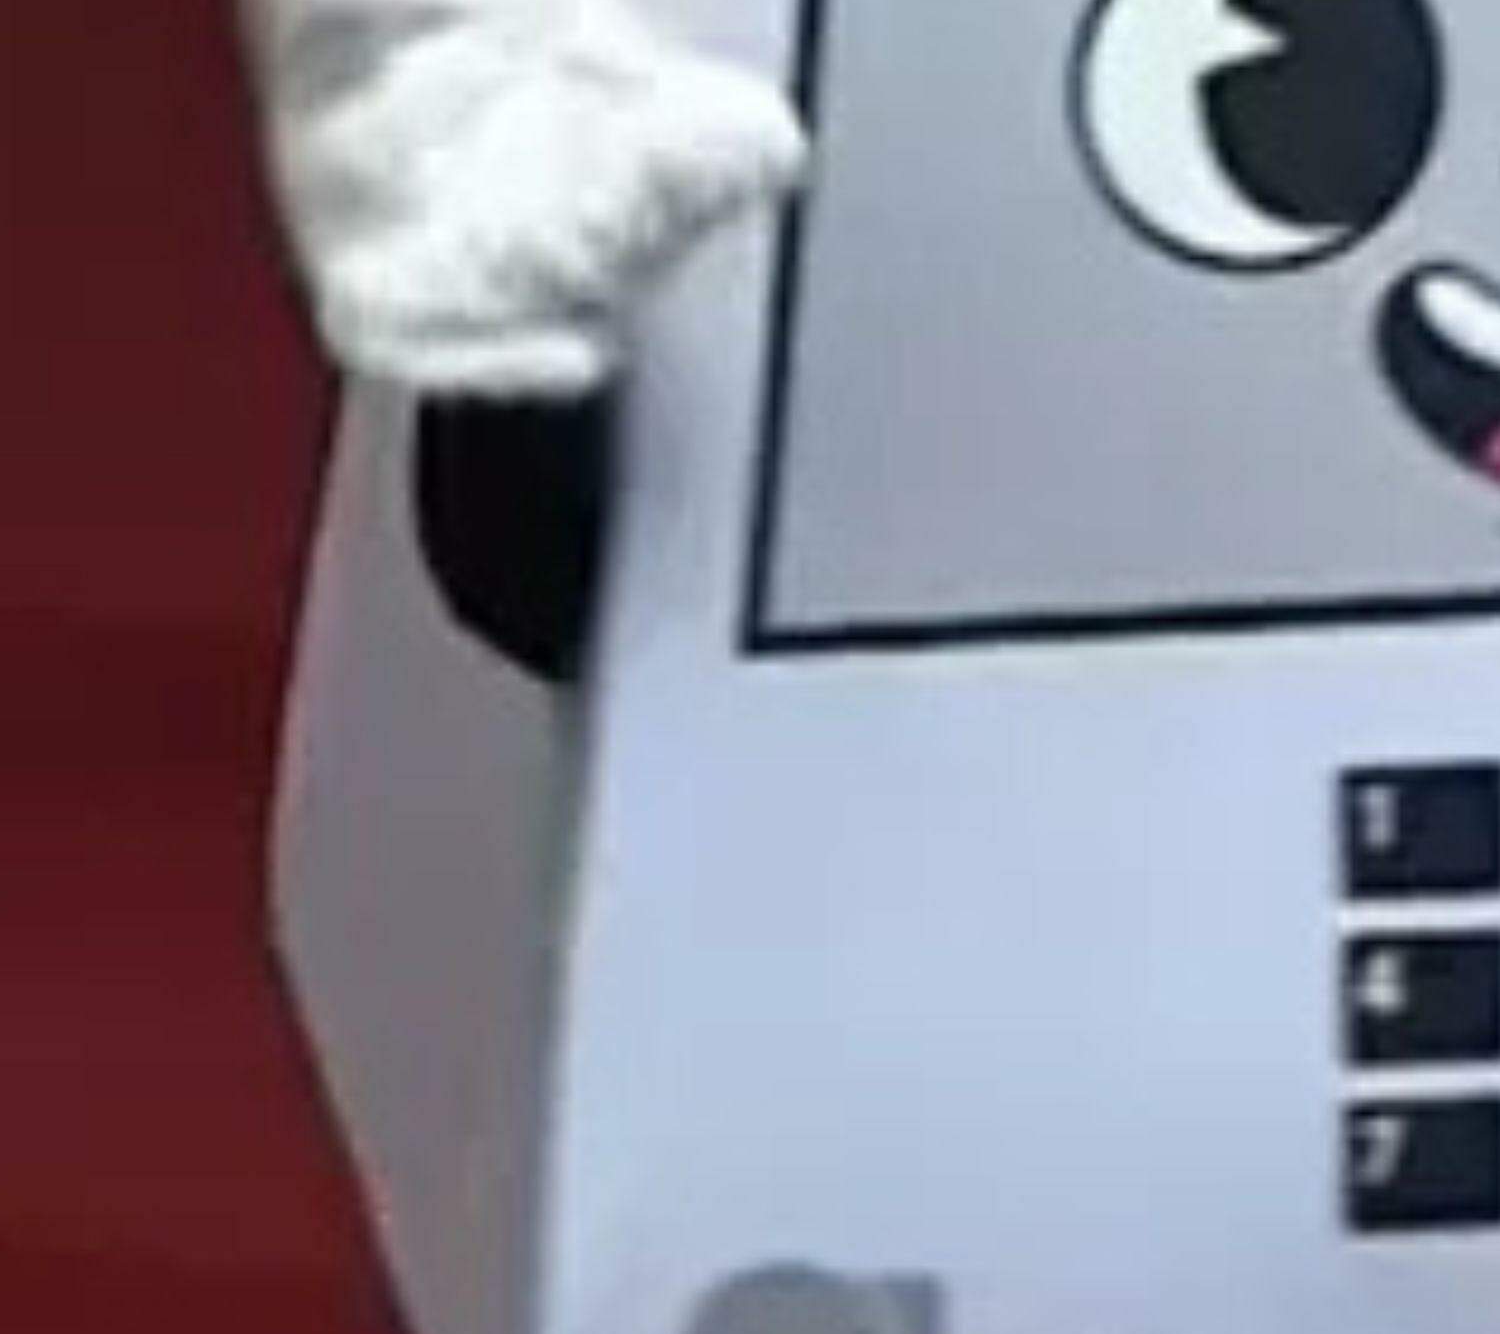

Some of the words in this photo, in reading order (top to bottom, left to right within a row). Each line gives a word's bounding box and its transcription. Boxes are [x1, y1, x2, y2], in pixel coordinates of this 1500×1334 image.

[1355, 781, 1399, 851] 1
[1352, 948, 1408, 1017] 4
[1353, 1112, 1408, 1186] 7
